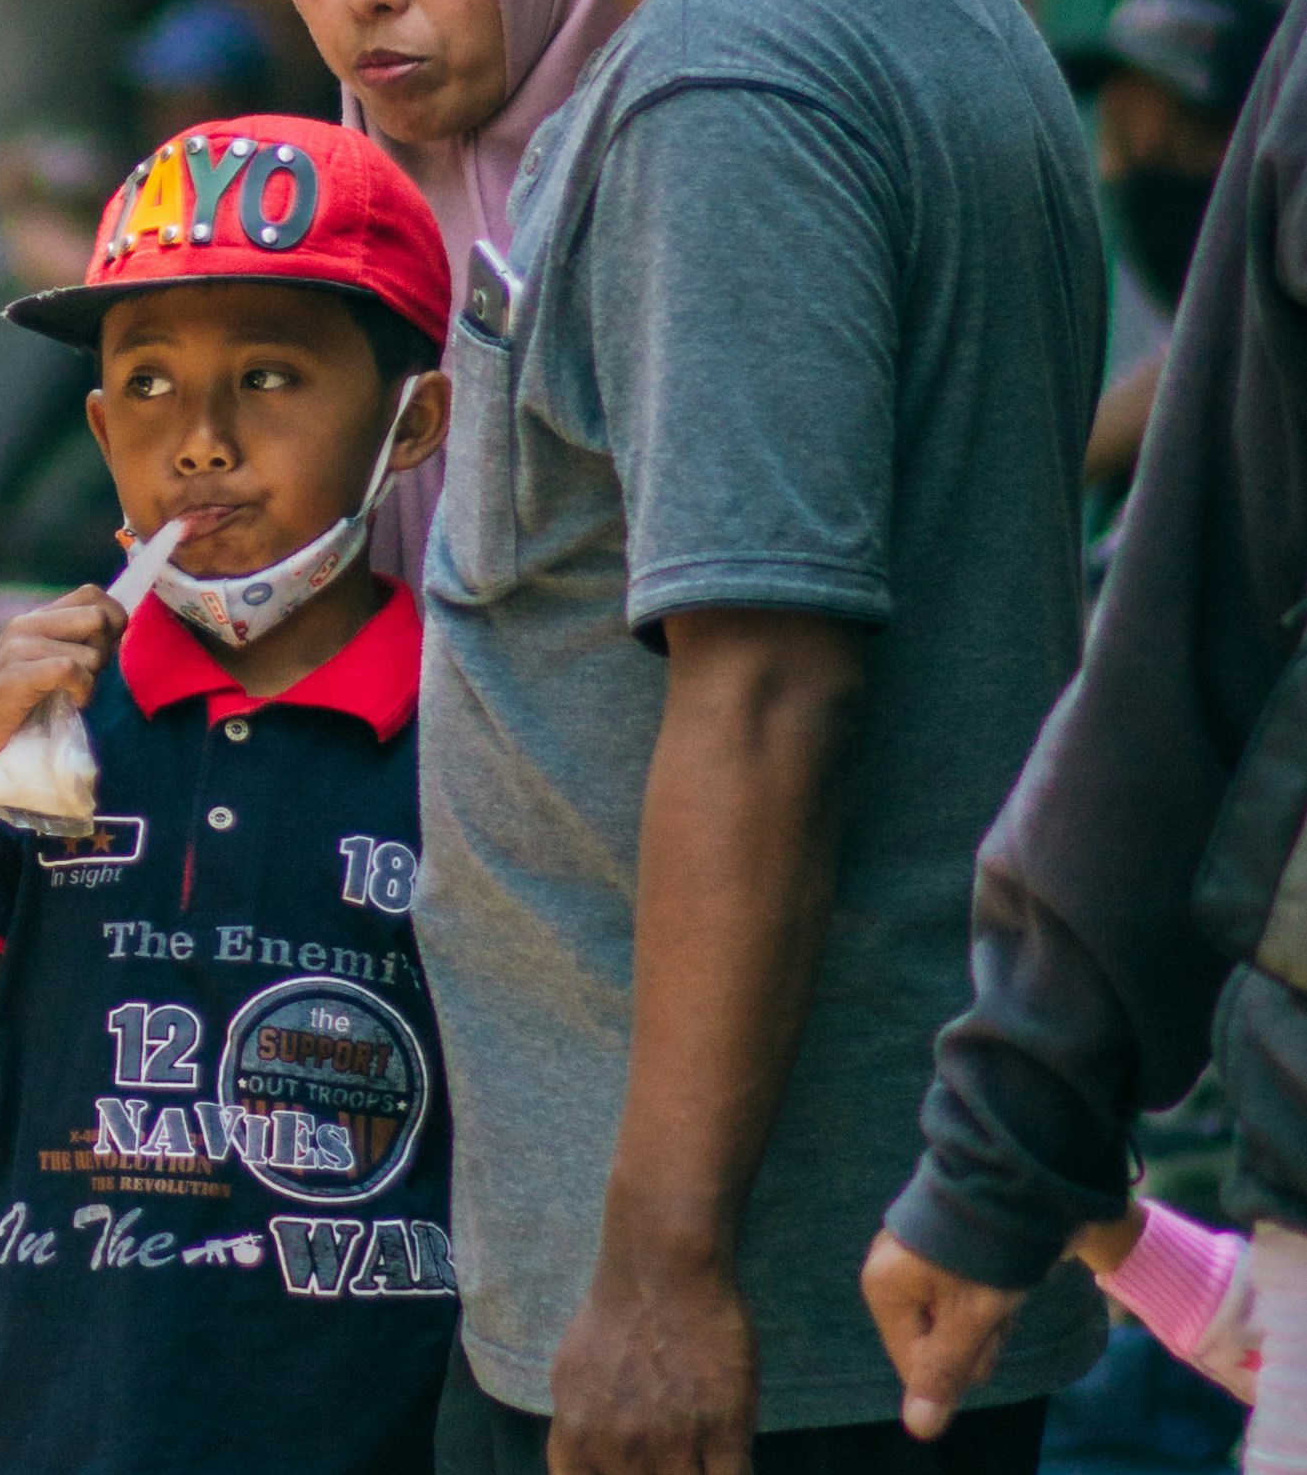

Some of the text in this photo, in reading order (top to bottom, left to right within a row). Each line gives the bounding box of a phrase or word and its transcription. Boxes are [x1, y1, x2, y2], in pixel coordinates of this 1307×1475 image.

[69, 864, 123, 889] sight
[339, 835, 417, 913] 18
[103, 920, 196, 960] The
[310, 1007, 350, 1032] the
[108, 1002, 201, 1088] 12
[257, 1026, 394, 1078] SUPPORT
[248, 1075, 394, 1113] OUT TROOPS
[72, 1202, 177, 1272] The
